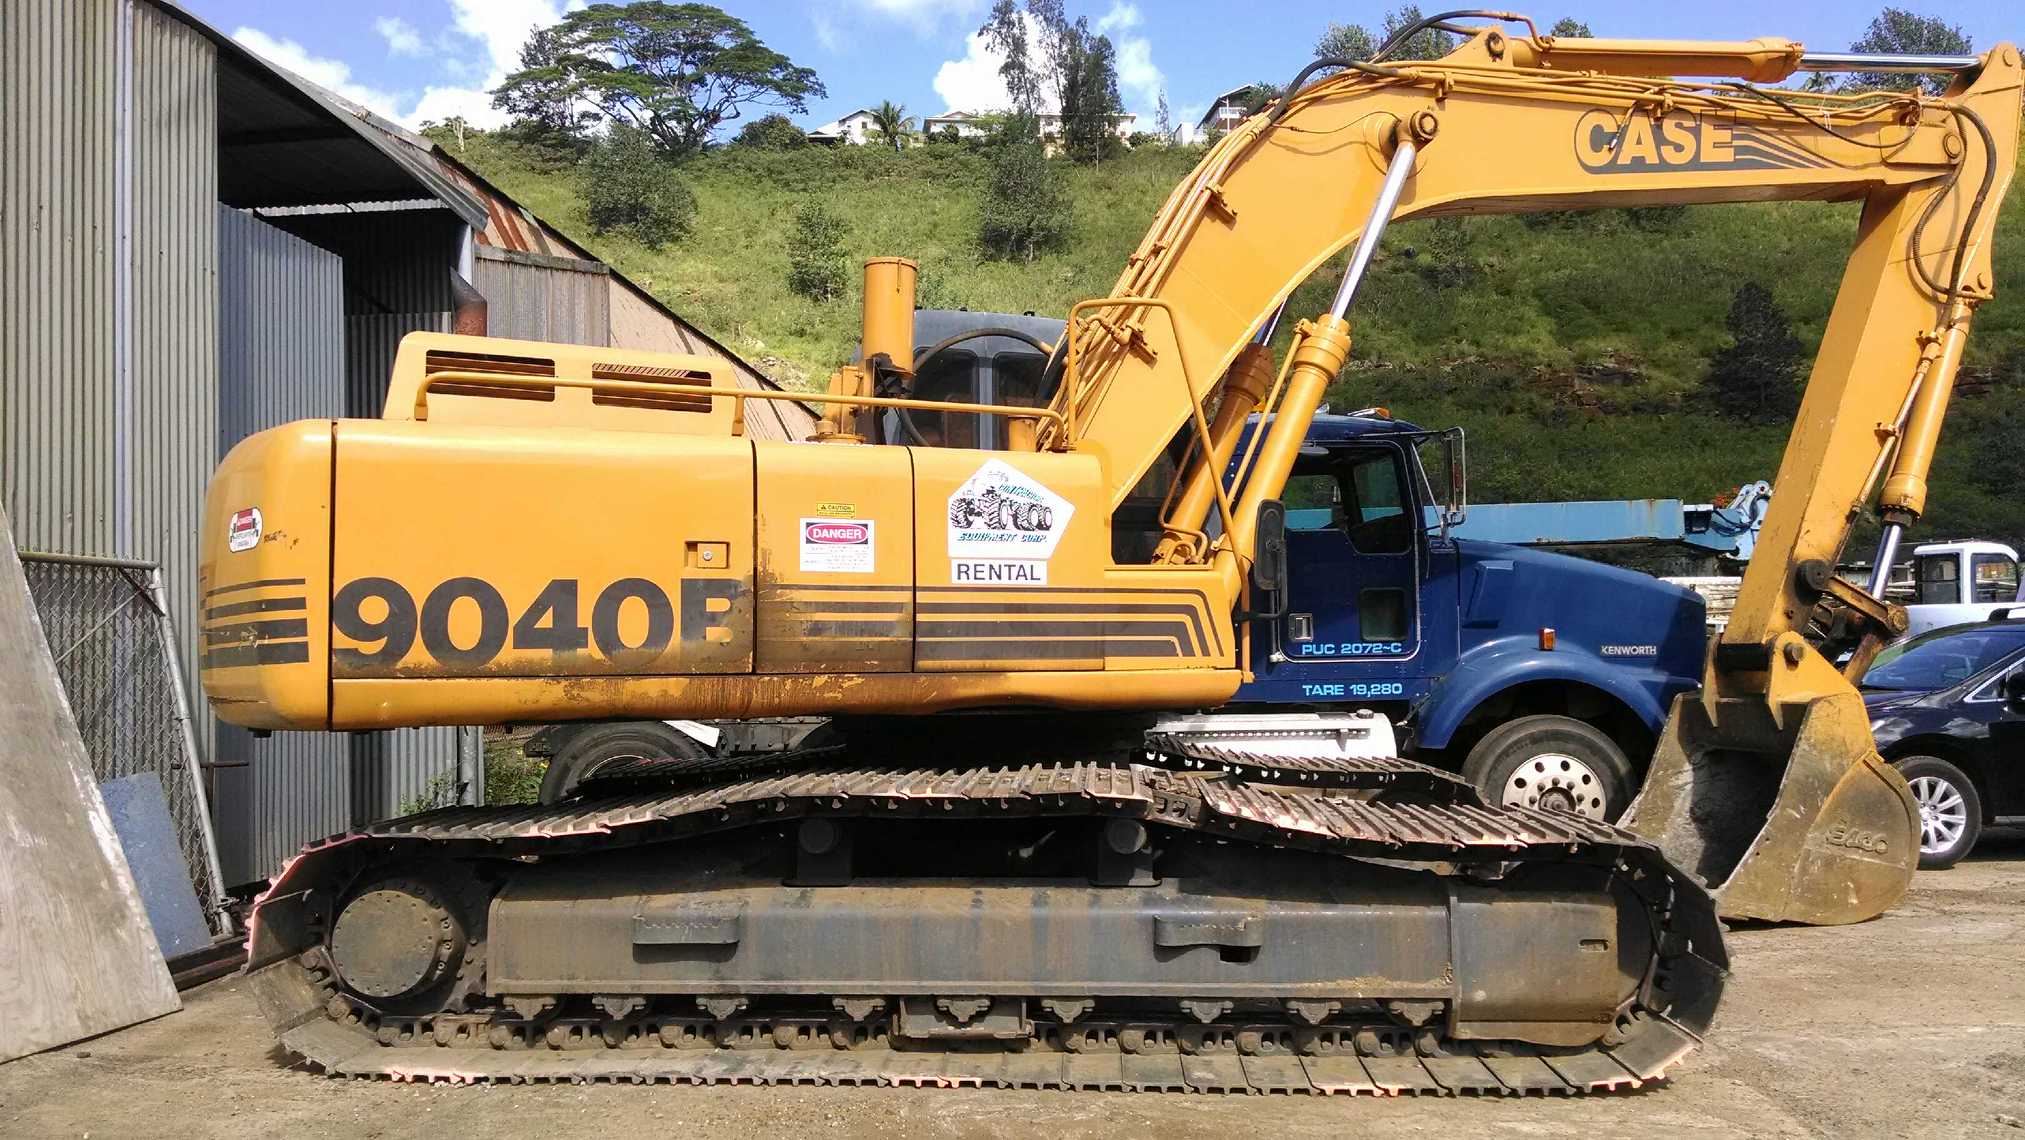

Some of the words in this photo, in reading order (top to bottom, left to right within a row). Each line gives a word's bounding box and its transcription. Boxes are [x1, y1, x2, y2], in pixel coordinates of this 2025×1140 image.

[1574, 108, 1736, 169] CASE
[812, 528, 863, 540] DANGER
[956, 563, 1042, 581] RENTAL
[331, 576, 752, 670] 9040B
[1302, 643, 1335, 655] PUC
[1600, 645, 1657, 655] KENWORTH
[1302, 684, 1345, 696] TARE
[1349, 683, 1403, 697] 19,280
